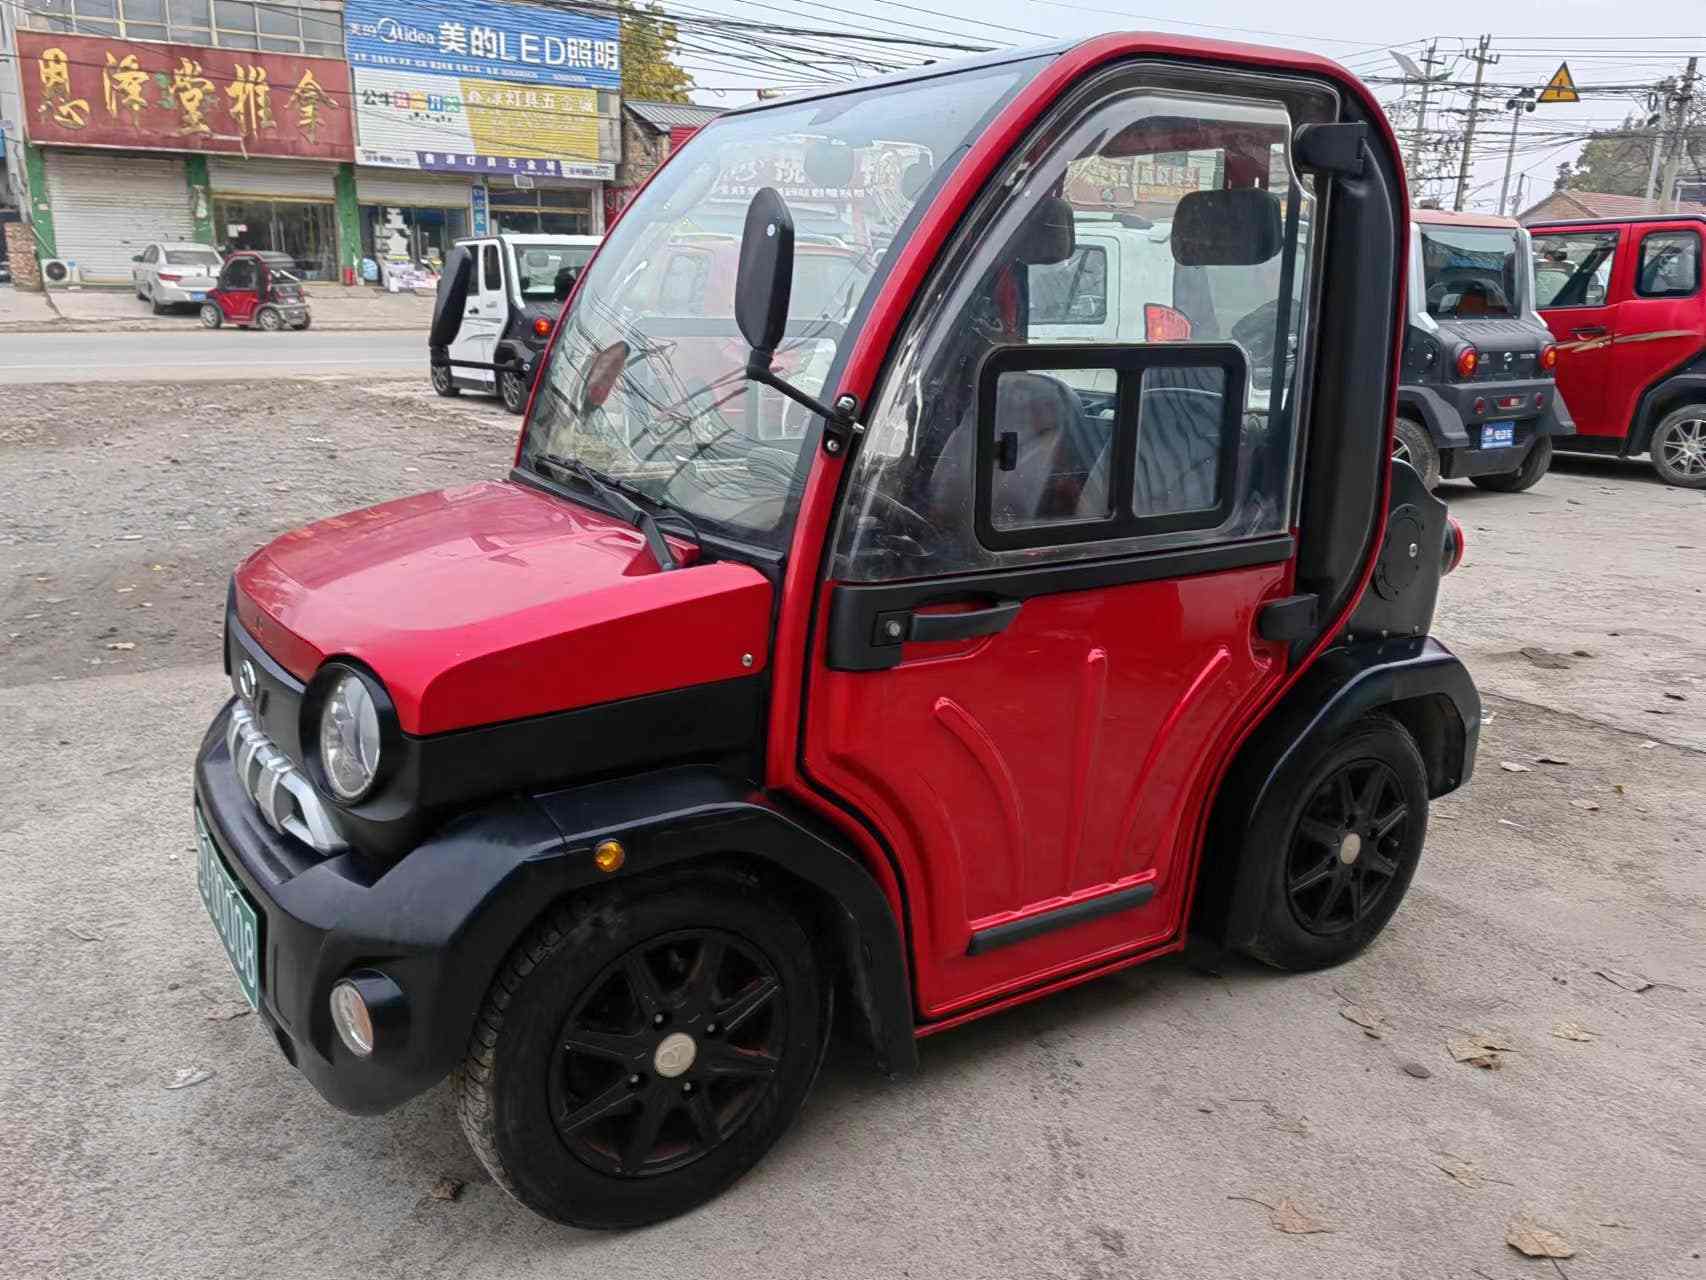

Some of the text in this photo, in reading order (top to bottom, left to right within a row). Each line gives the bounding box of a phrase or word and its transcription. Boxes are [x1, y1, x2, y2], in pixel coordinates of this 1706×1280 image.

[382, 19, 435, 45] Midea
[438, 21, 618, 70] 美的LED照明
